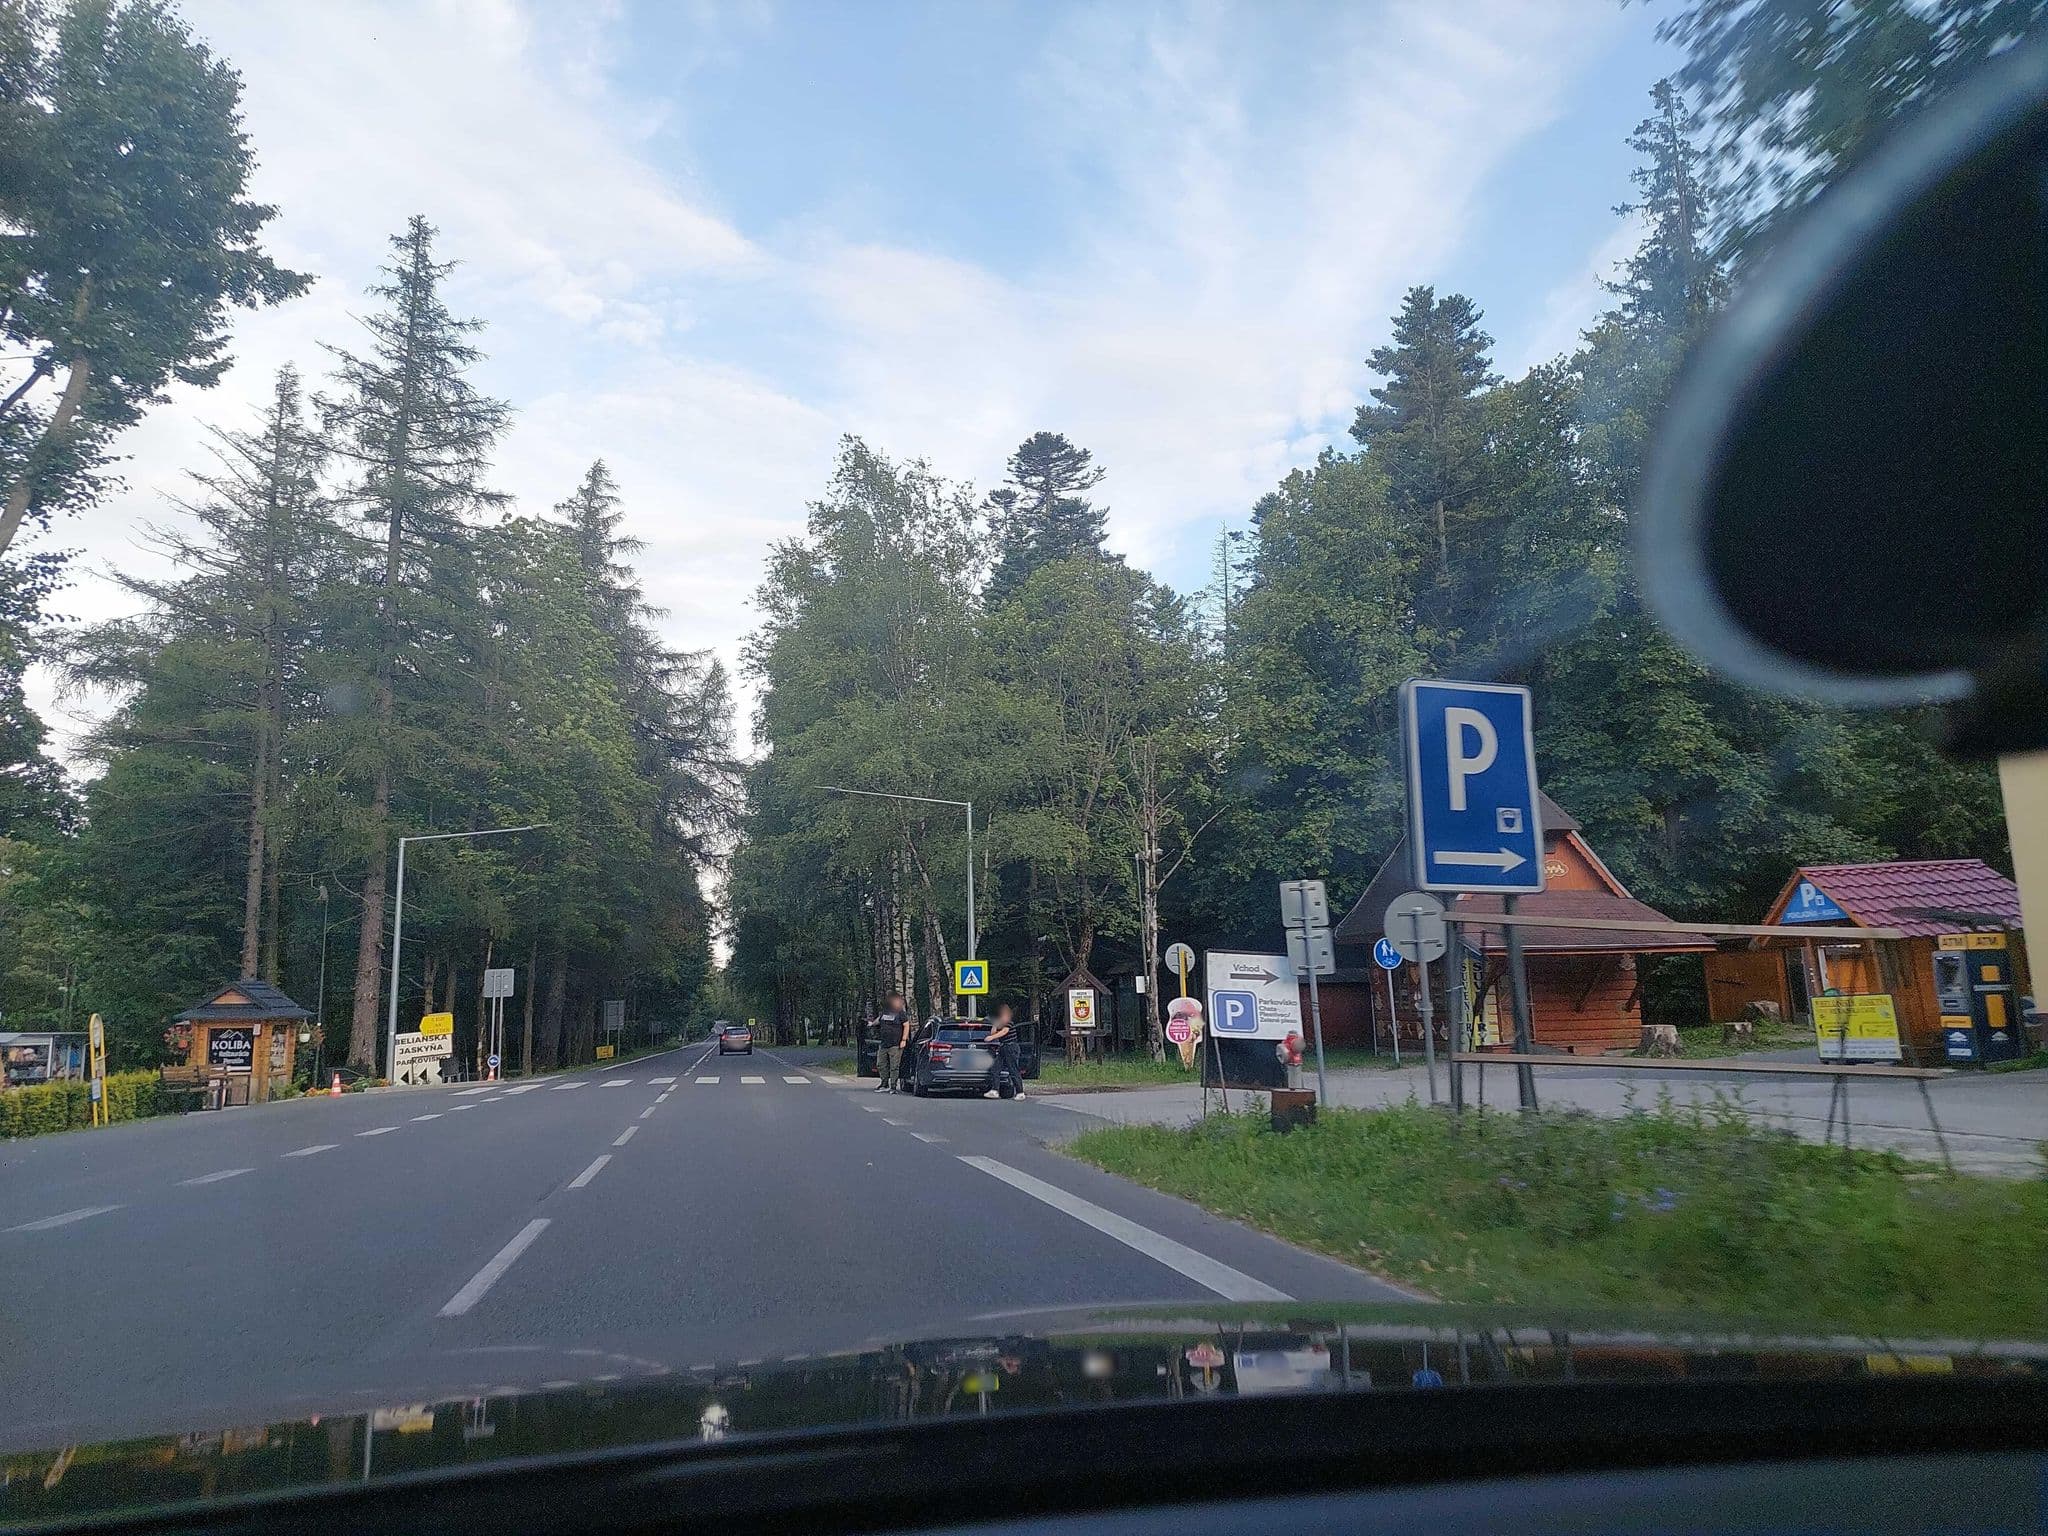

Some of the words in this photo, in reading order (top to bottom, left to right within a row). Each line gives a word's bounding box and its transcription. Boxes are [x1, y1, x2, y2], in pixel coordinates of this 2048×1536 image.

[1444, 707, 1499, 811] P
[1800, 883, 1816, 907] P
[1233, 964, 1260, 972] Vchod
[1225, 999, 1245, 1026] P
[1173, 1032, 1187, 1040] TU
[211, 1040, 252, 1050] KOLIBA
[400, 1043, 443, 1055] JASKYŇA
